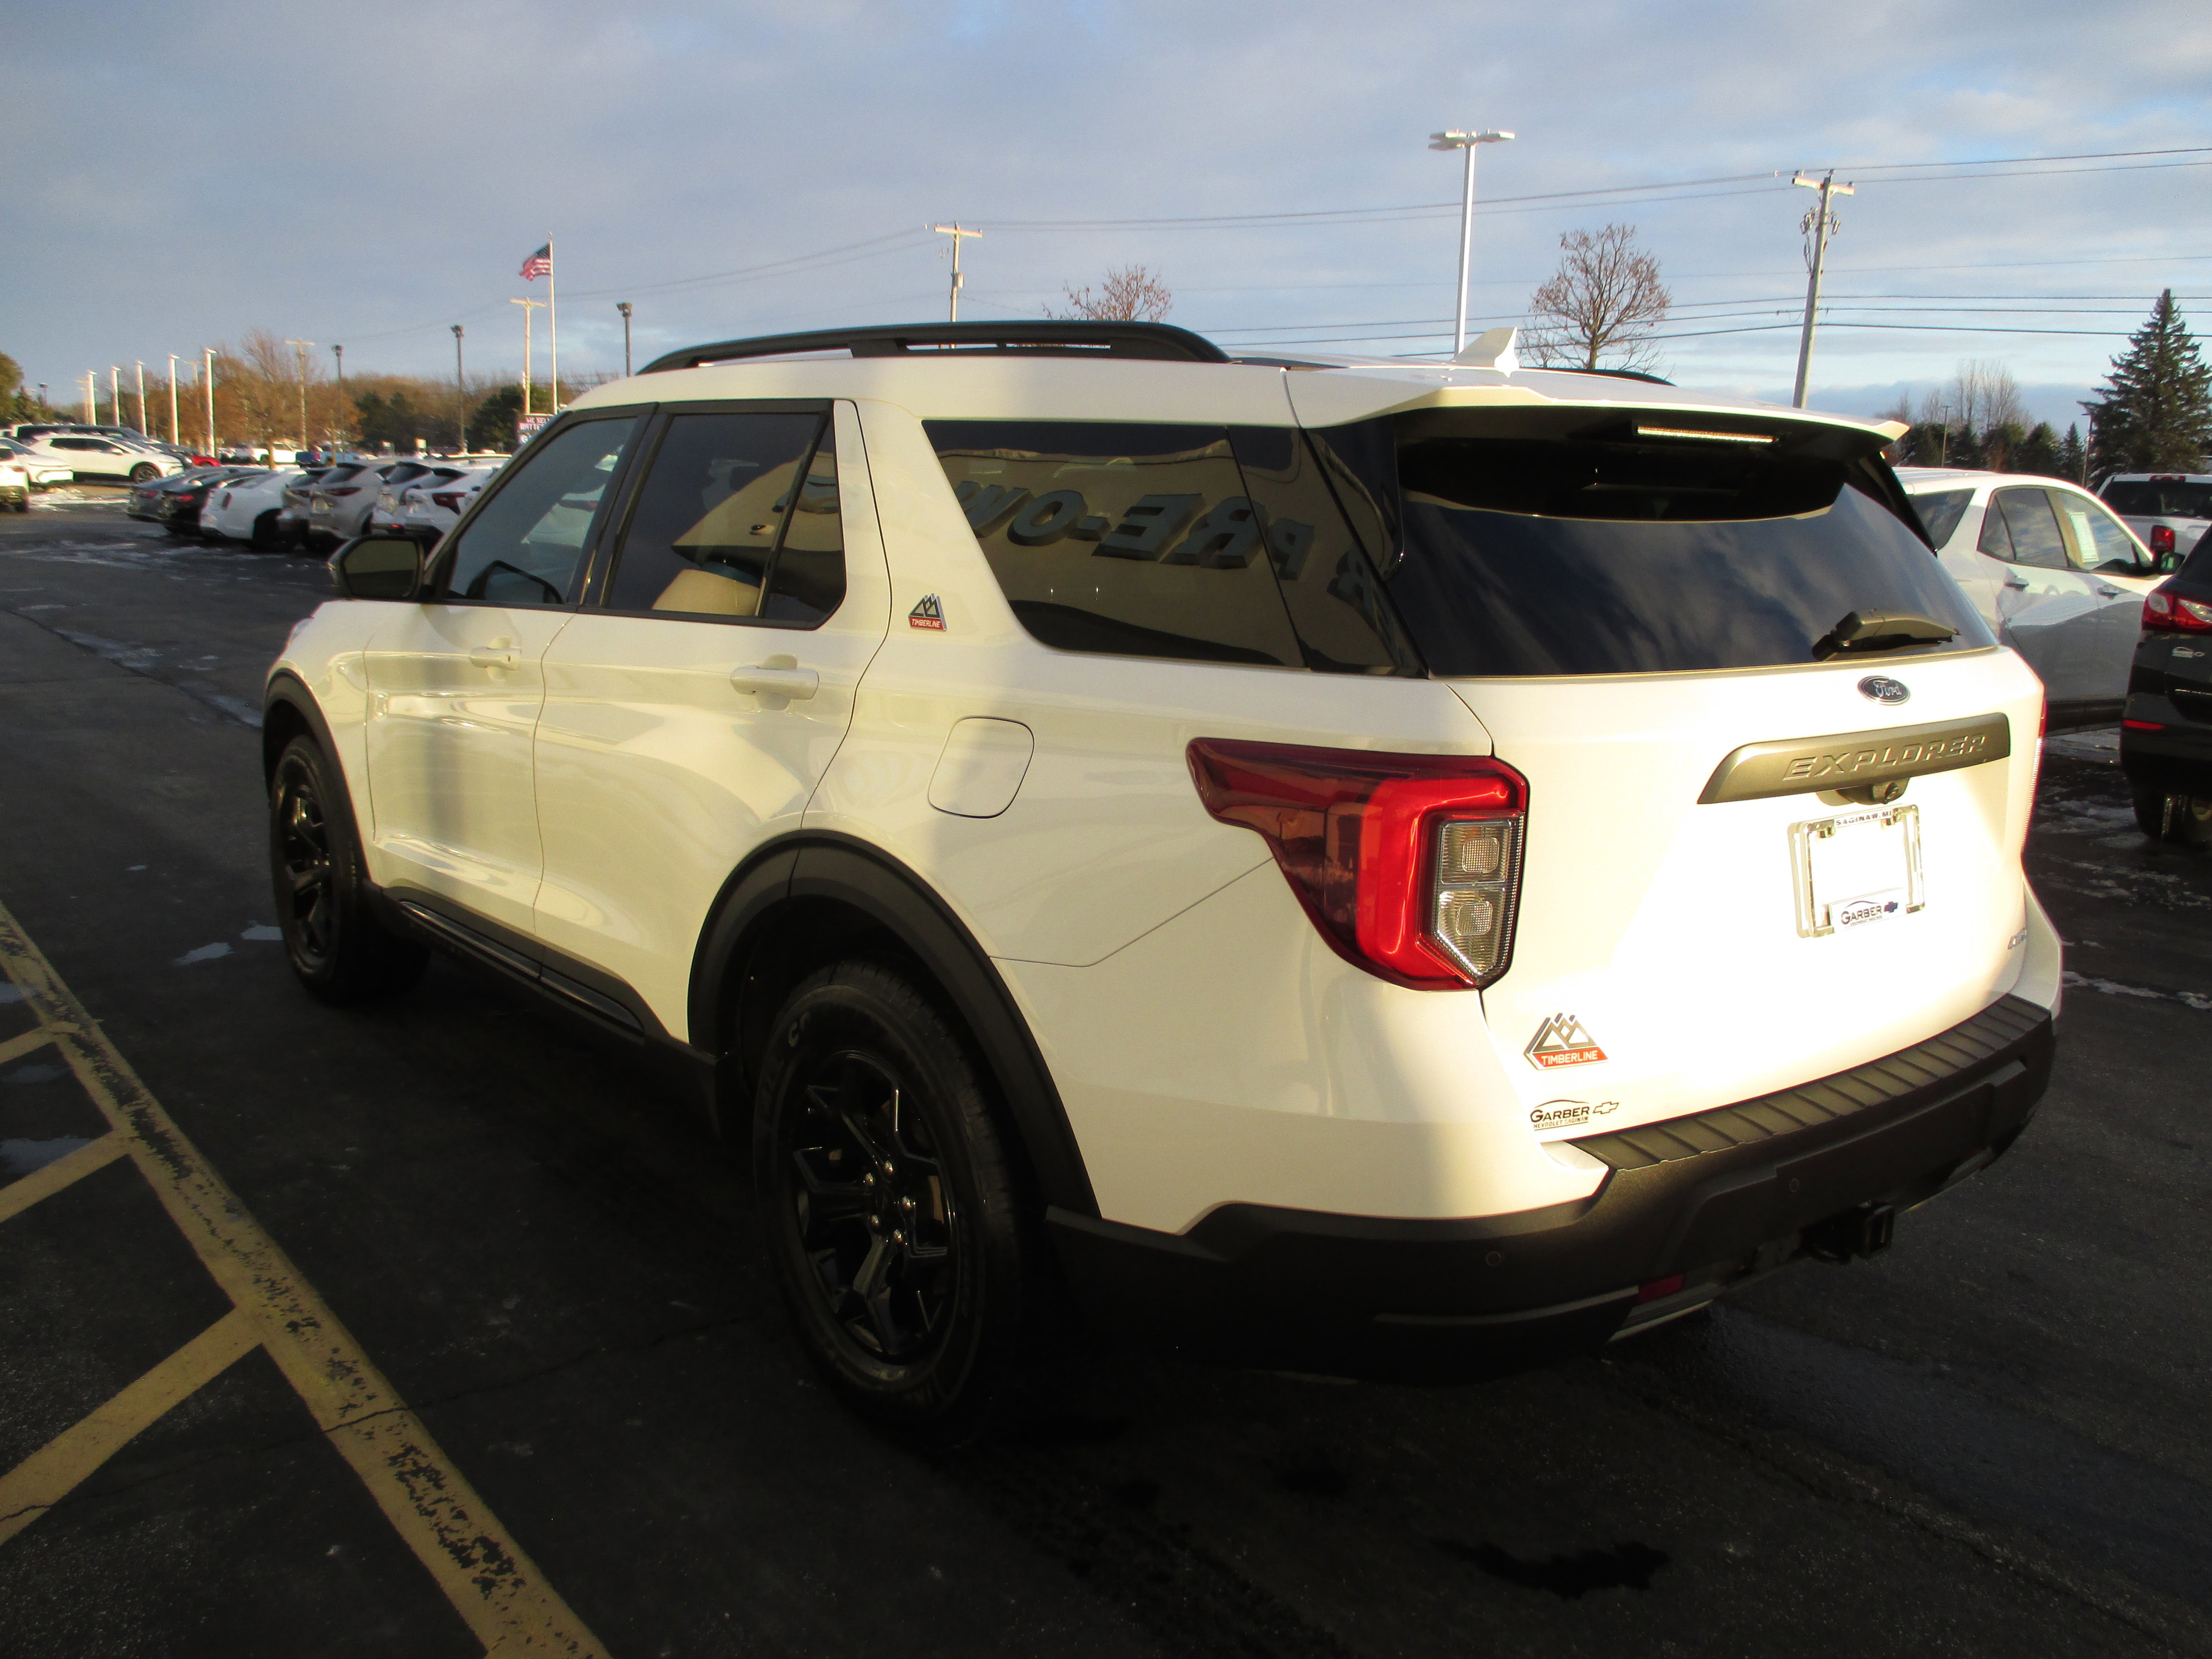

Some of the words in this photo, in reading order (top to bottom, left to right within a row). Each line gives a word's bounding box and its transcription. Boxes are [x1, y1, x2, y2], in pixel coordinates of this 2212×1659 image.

[912, 619, 941, 627] TIMBERLINE
[1873, 680, 1902, 697] Ford
[1783, 734, 1986, 781] EXPLORER
[1841, 905, 1883, 925] GARBER
[1541, 1050, 1598, 1065] TIMBERLINE
[1530, 1106, 1590, 1122] GARBER
[1564, 1116, 1588, 1124] SAGINAW
